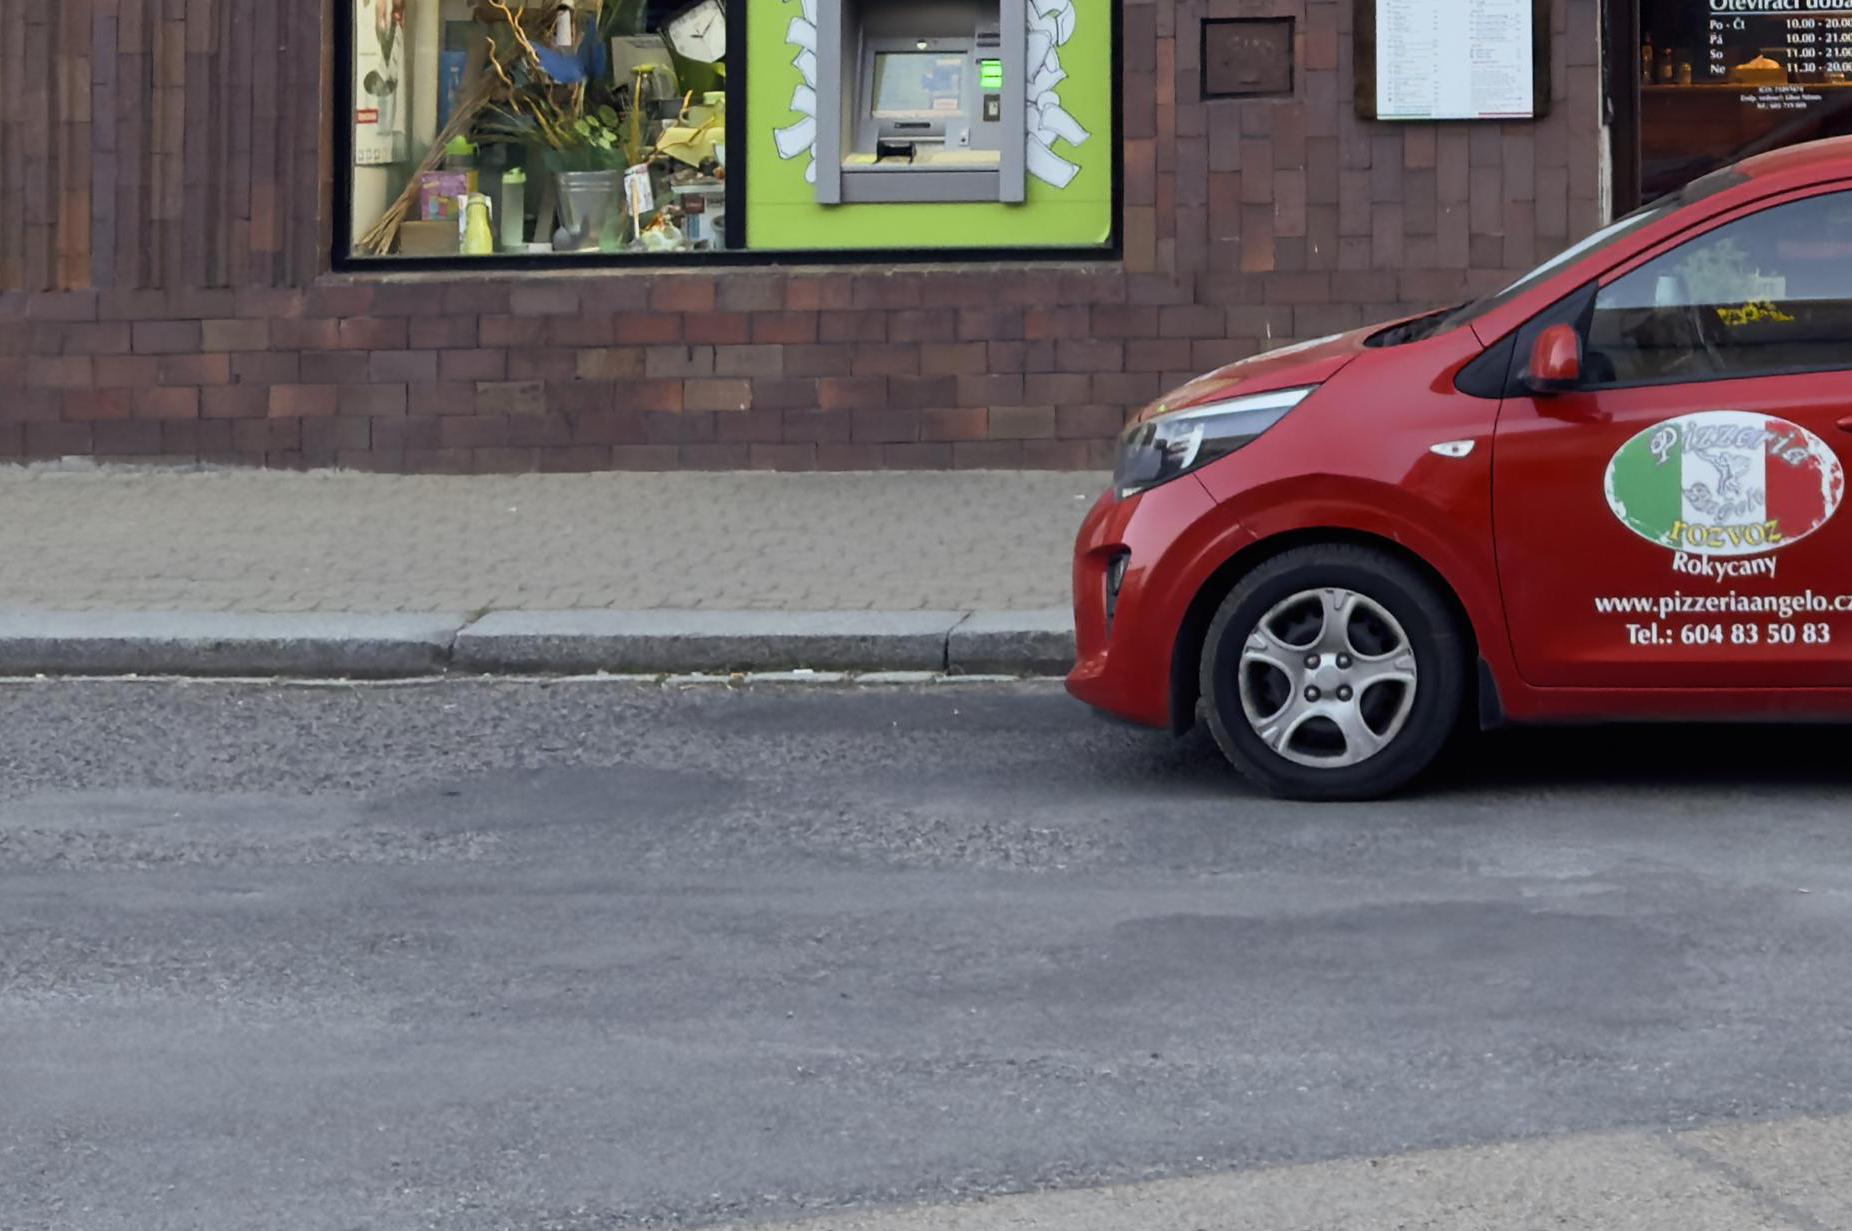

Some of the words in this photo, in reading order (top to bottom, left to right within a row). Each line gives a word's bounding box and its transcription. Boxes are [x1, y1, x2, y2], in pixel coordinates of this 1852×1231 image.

[1709, 20, 1723, 30] Po
[1786, 19, 1815, 29] 10.00
[1709, 33, 1723, 45] Pá
[1786, 34, 1815, 43] 10.00
[1710, 49, 1724, 59] So
[1787, 48, 1816, 57] 11.00
[1710, 64, 1726, 74] Ne
[1787, 62, 1816, 72] 11.30
[1649, 421, 1810, 466] Pizzeria
[1668, 519, 1784, 548] rozvoz
[1672, 551, 1777, 583] Rokycany
[1626, 622, 1673, 644] Tel.:
[1681, 624, 1723, 644] 604
[1731, 623, 1759, 643] 83
[1767, 623, 1796, 643] 50
[1802, 622, 1831, 643] 83
